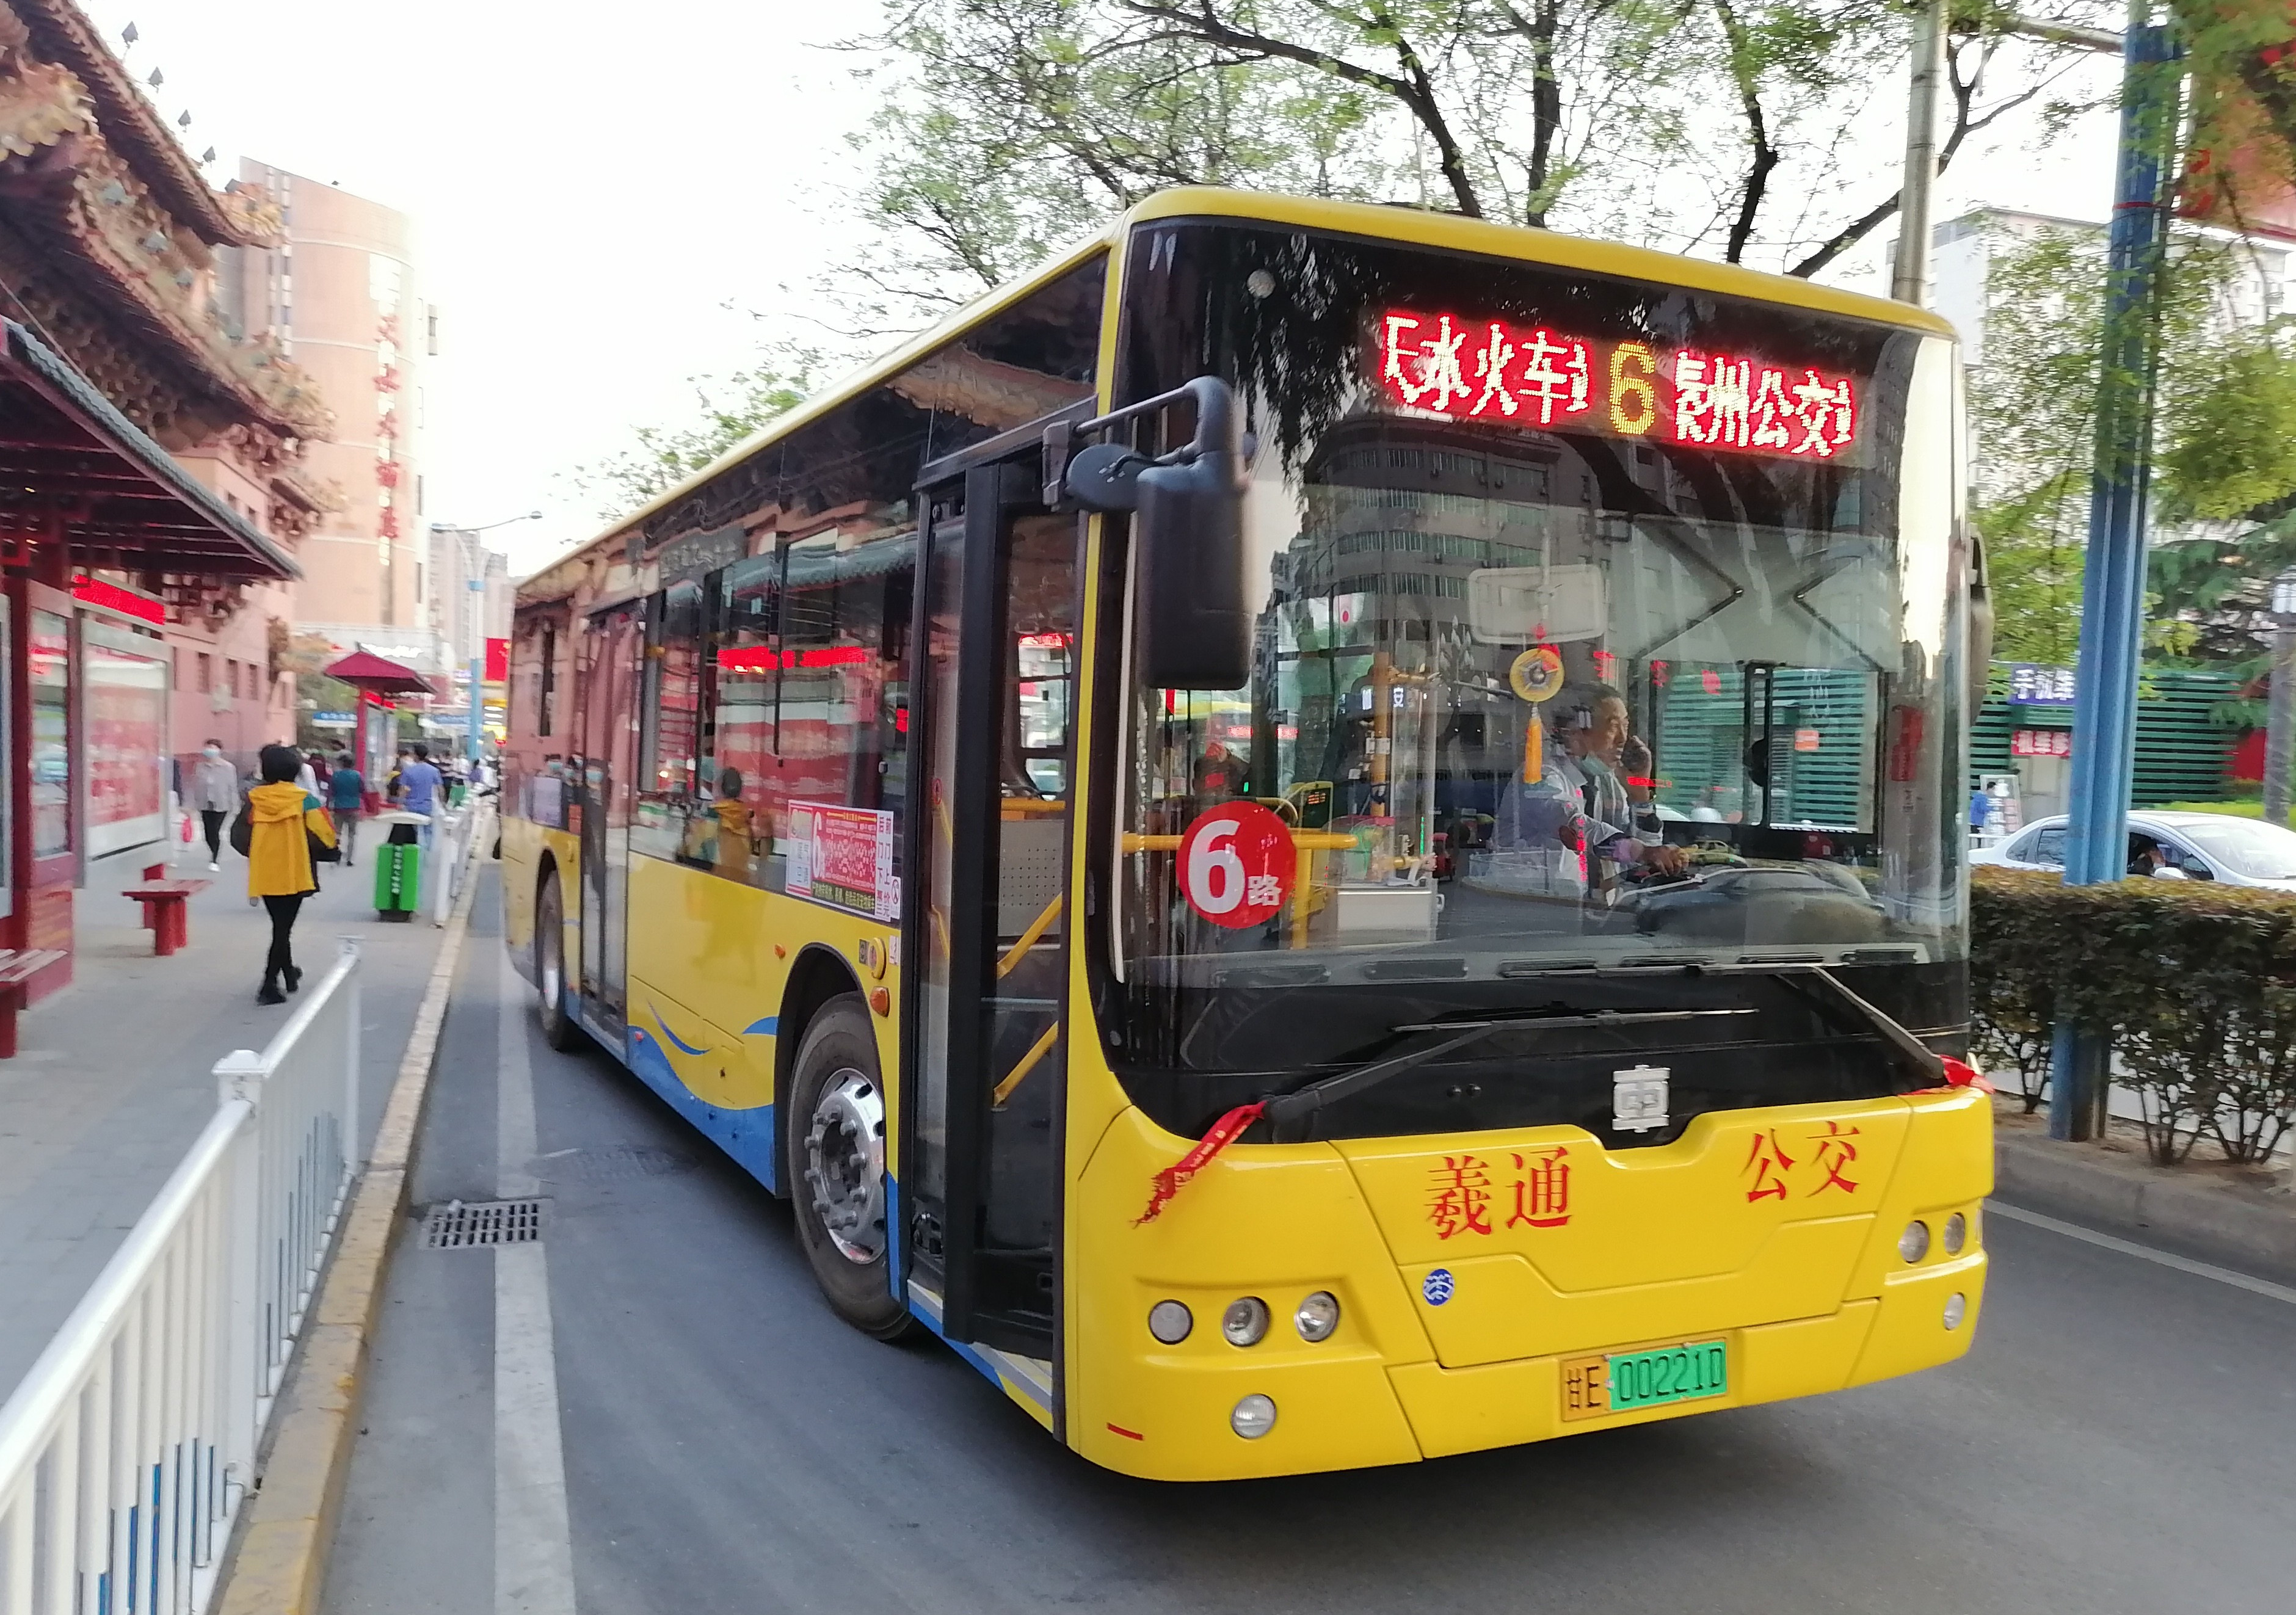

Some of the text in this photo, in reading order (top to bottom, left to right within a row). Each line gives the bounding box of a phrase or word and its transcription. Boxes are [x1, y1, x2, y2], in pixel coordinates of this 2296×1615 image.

[1610, 341, 1655, 435] 6
[1423, 1121, 1859, 1240] 羲通 公交
